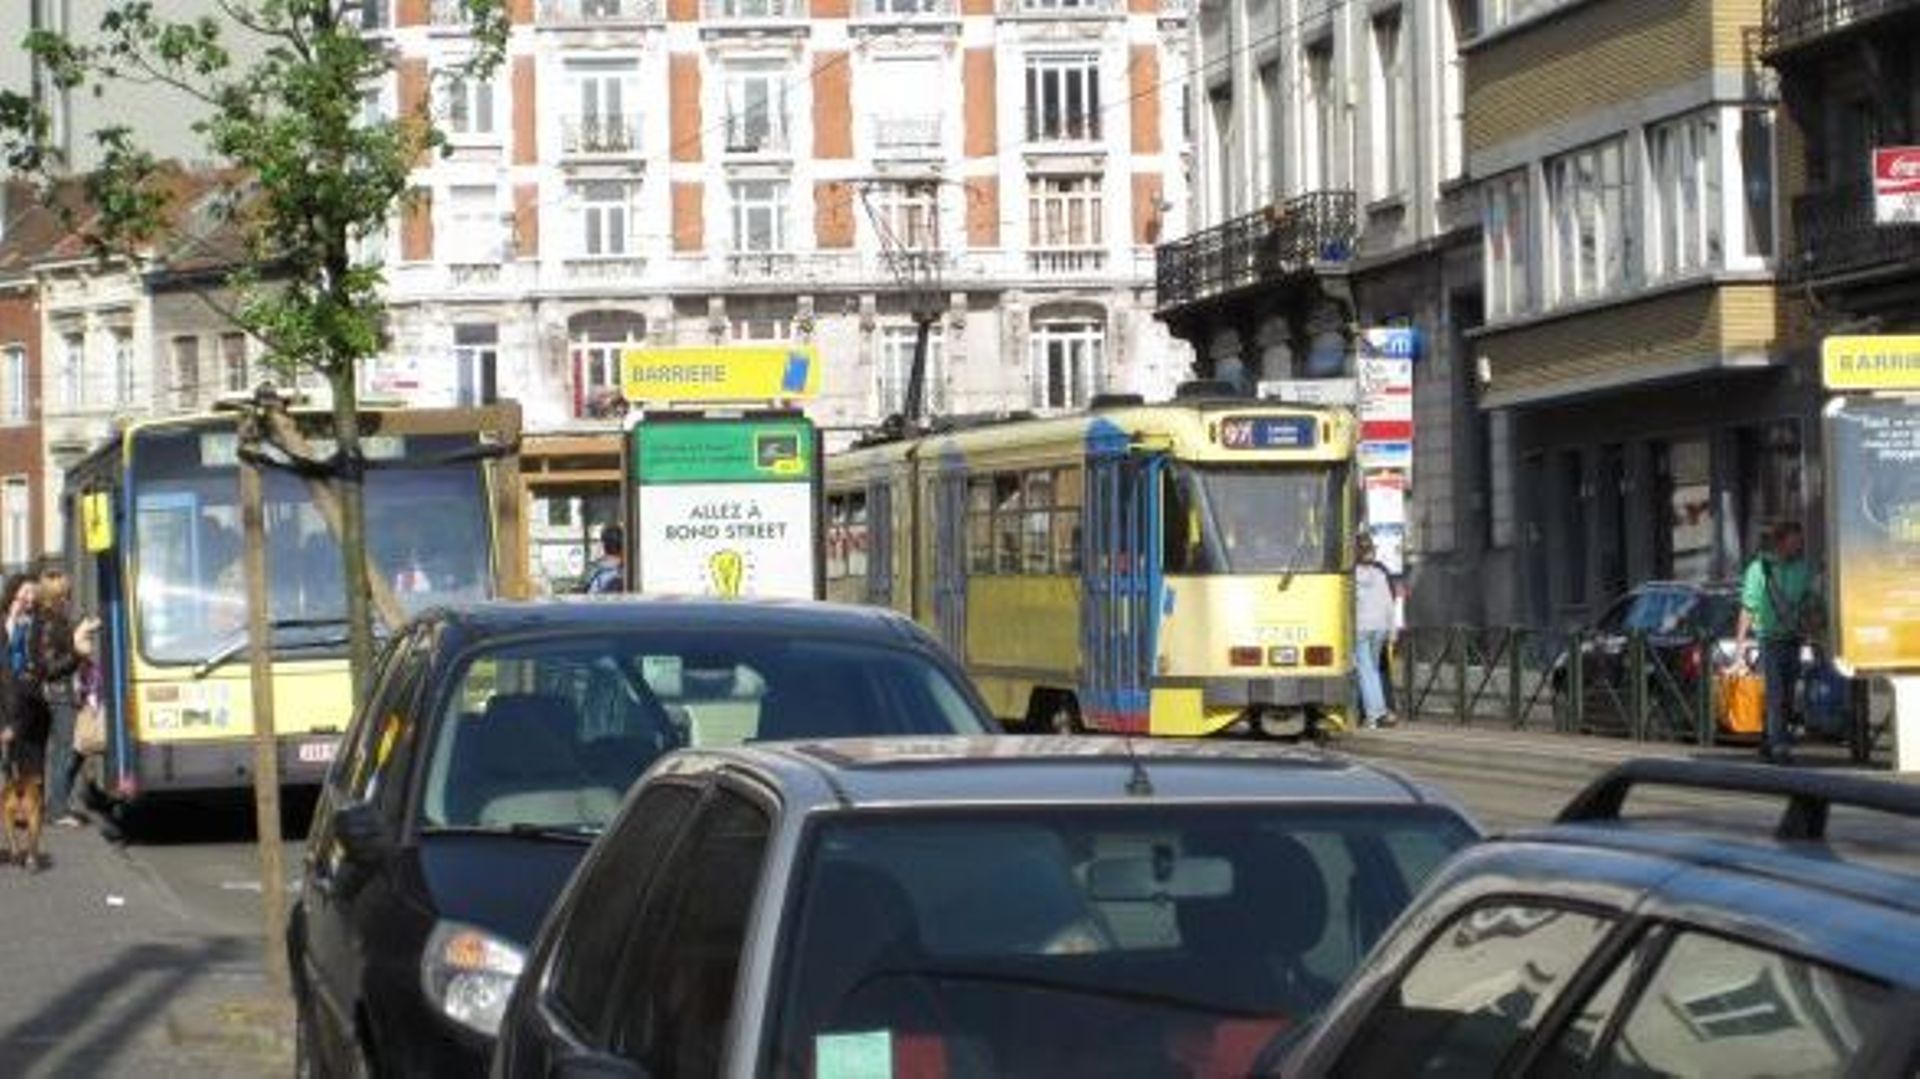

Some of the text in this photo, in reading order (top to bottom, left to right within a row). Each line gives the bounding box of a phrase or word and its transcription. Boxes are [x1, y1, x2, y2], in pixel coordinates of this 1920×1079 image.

[632, 365, 726, 383] BARRIERE
[689, 503, 742, 519] ALLEZ
[665, 522, 788, 540] BOND STREET
